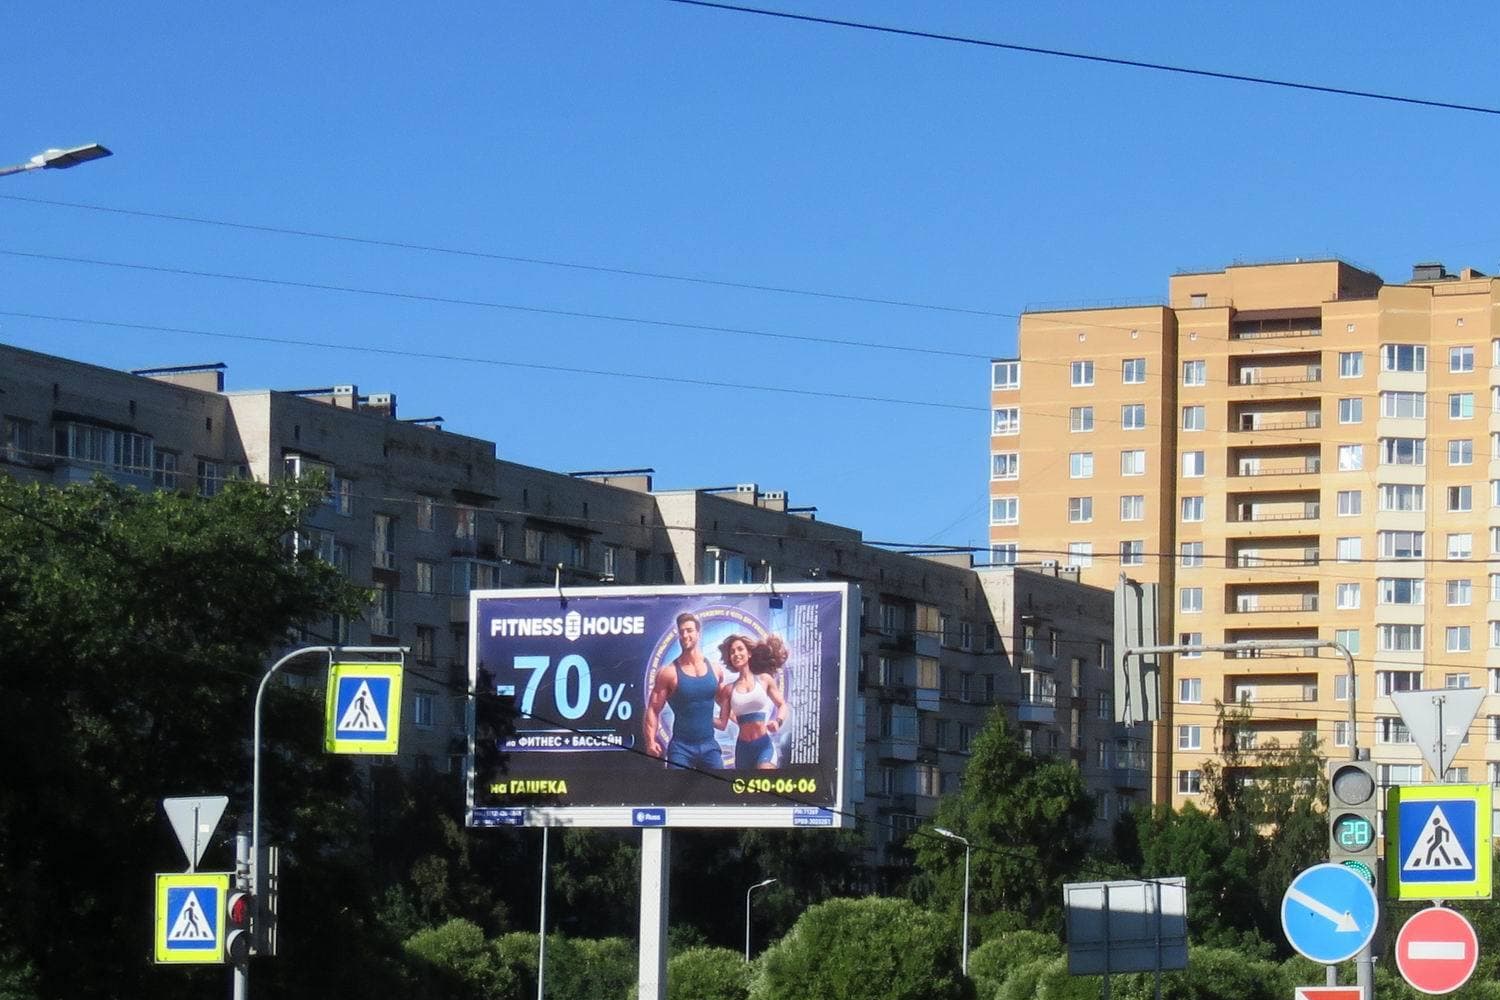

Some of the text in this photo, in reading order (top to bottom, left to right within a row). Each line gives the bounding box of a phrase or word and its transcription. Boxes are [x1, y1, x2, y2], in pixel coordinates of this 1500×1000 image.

[490, 616, 645, 637] FITNESS HOUSE
[518, 736, 562, 747] ФИТНЕС
[490, 780, 568, 794] на ГАШЕКА
[1341, 821, 1368, 845] 28
